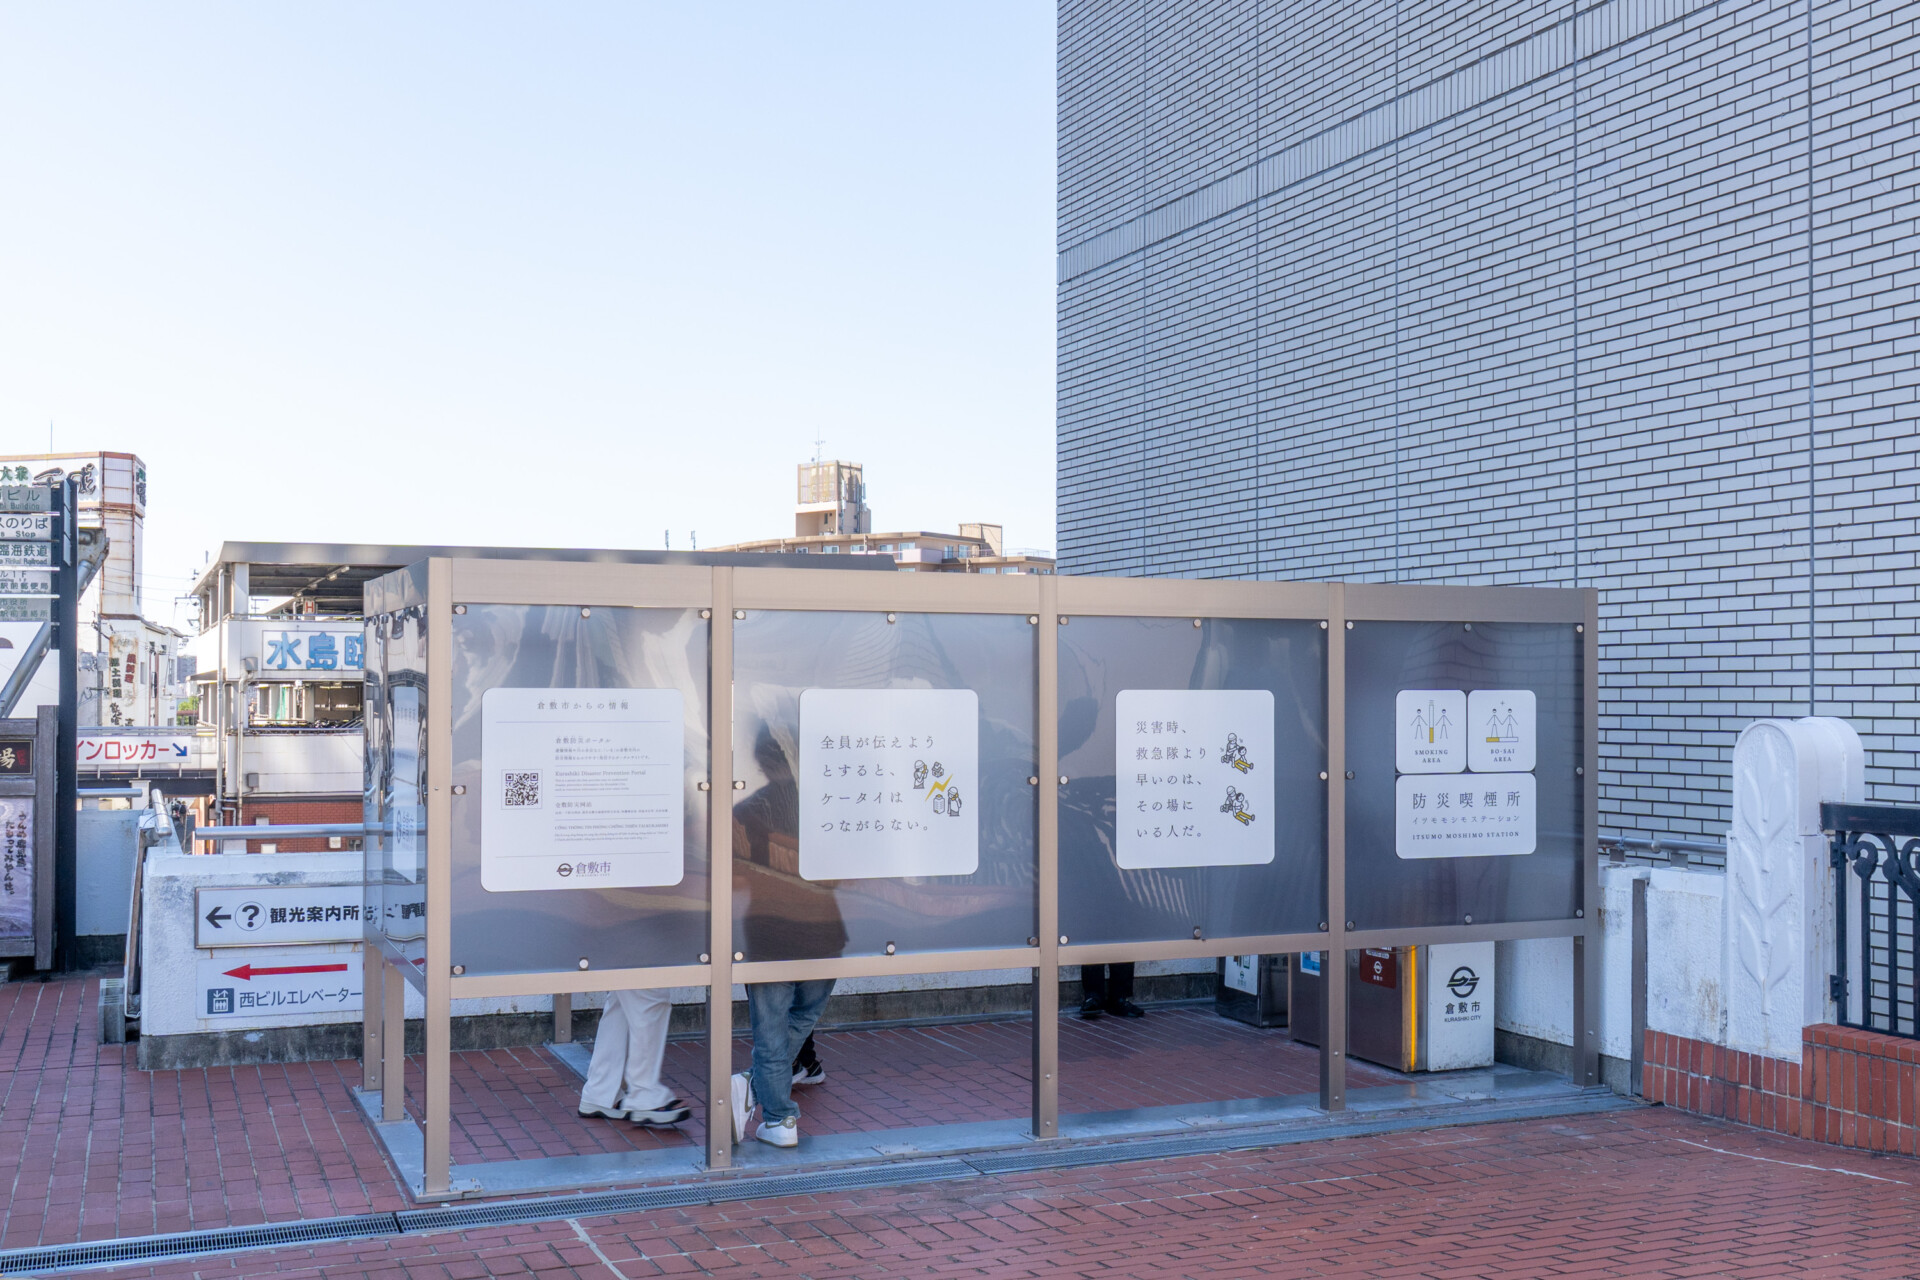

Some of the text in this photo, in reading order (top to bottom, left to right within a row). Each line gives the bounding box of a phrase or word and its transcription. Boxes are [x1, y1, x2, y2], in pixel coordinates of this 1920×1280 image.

[0, 489, 40, 501] ビル
[305, 601, 314, 613] H
[537, 701, 630, 711] 倉敷市からの情報
[1136, 720, 1188, 734] 災害時、
[821, 735, 935, 750] 全員が伝えよう
[1135, 746, 1207, 760] 救急隊より
[822, 763, 896, 777] とすると、
[1135, 773, 1204, 787] 早いのは、
[821, 791, 903, 805] ケータイは
[1136, 798, 1194, 812] その場に
[1412, 790, 1521, 810] 防災喫煙所
[821, 819, 929, 832] つながらない。
[1412, 815, 1520, 825] イツモモシモステーション
[1136, 824, 1203, 838] いる人だ。
[1412, 833, 1443, 841] ITSUMO
[1445, 831, 1484, 840] MOSHIMO
[576, 861, 612, 874] 倉敷市
[270, 905, 360, 924] 観光案内所
[239, 988, 363, 1009] 西ビルエレベーター
[1445, 1001, 1481, 1014] 倉敷市
